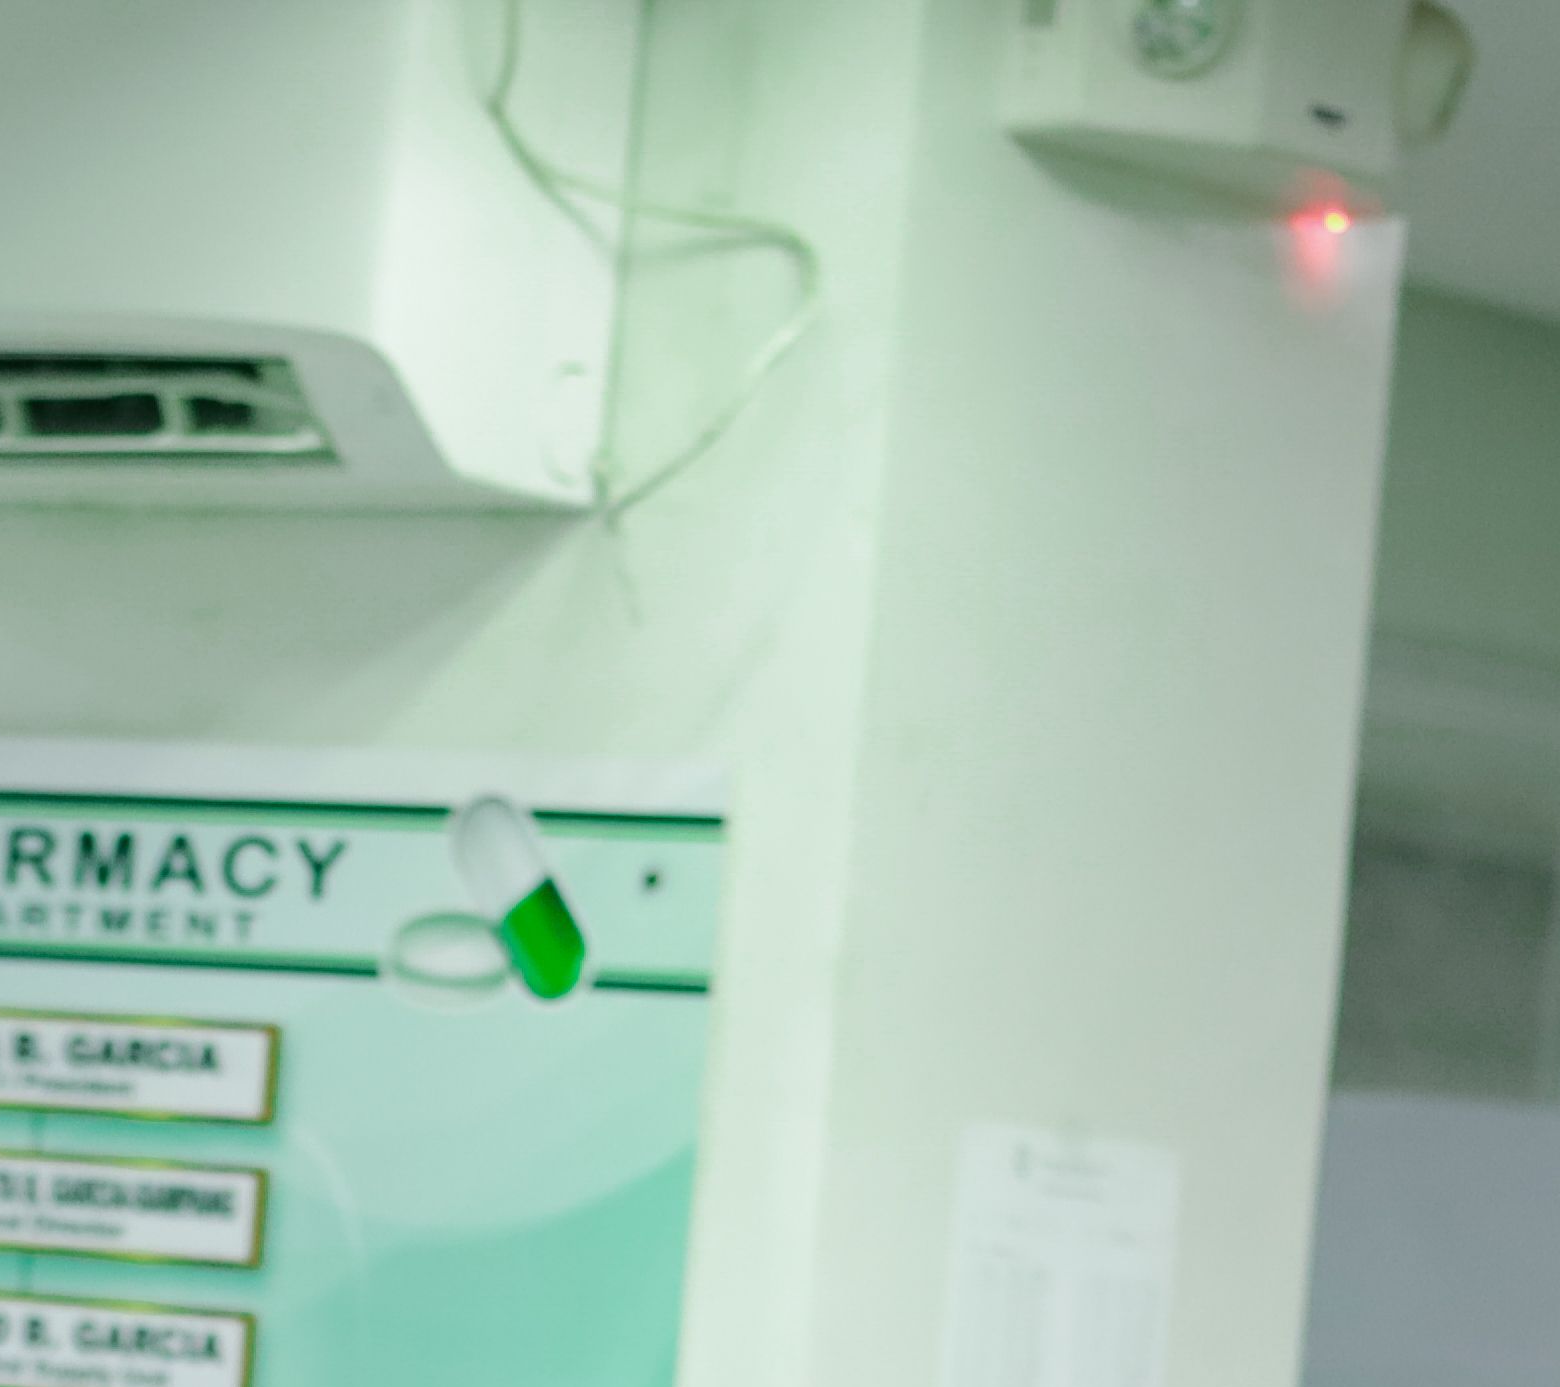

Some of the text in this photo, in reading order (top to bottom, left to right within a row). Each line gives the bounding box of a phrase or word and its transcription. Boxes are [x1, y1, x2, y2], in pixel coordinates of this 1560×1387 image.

[14, 1030, 49, 1063] B.
[66, 1035, 219, 1074] GARCIA
[25, 1317, 60, 1350] B.
[75, 1321, 219, 1361] GARCIA
